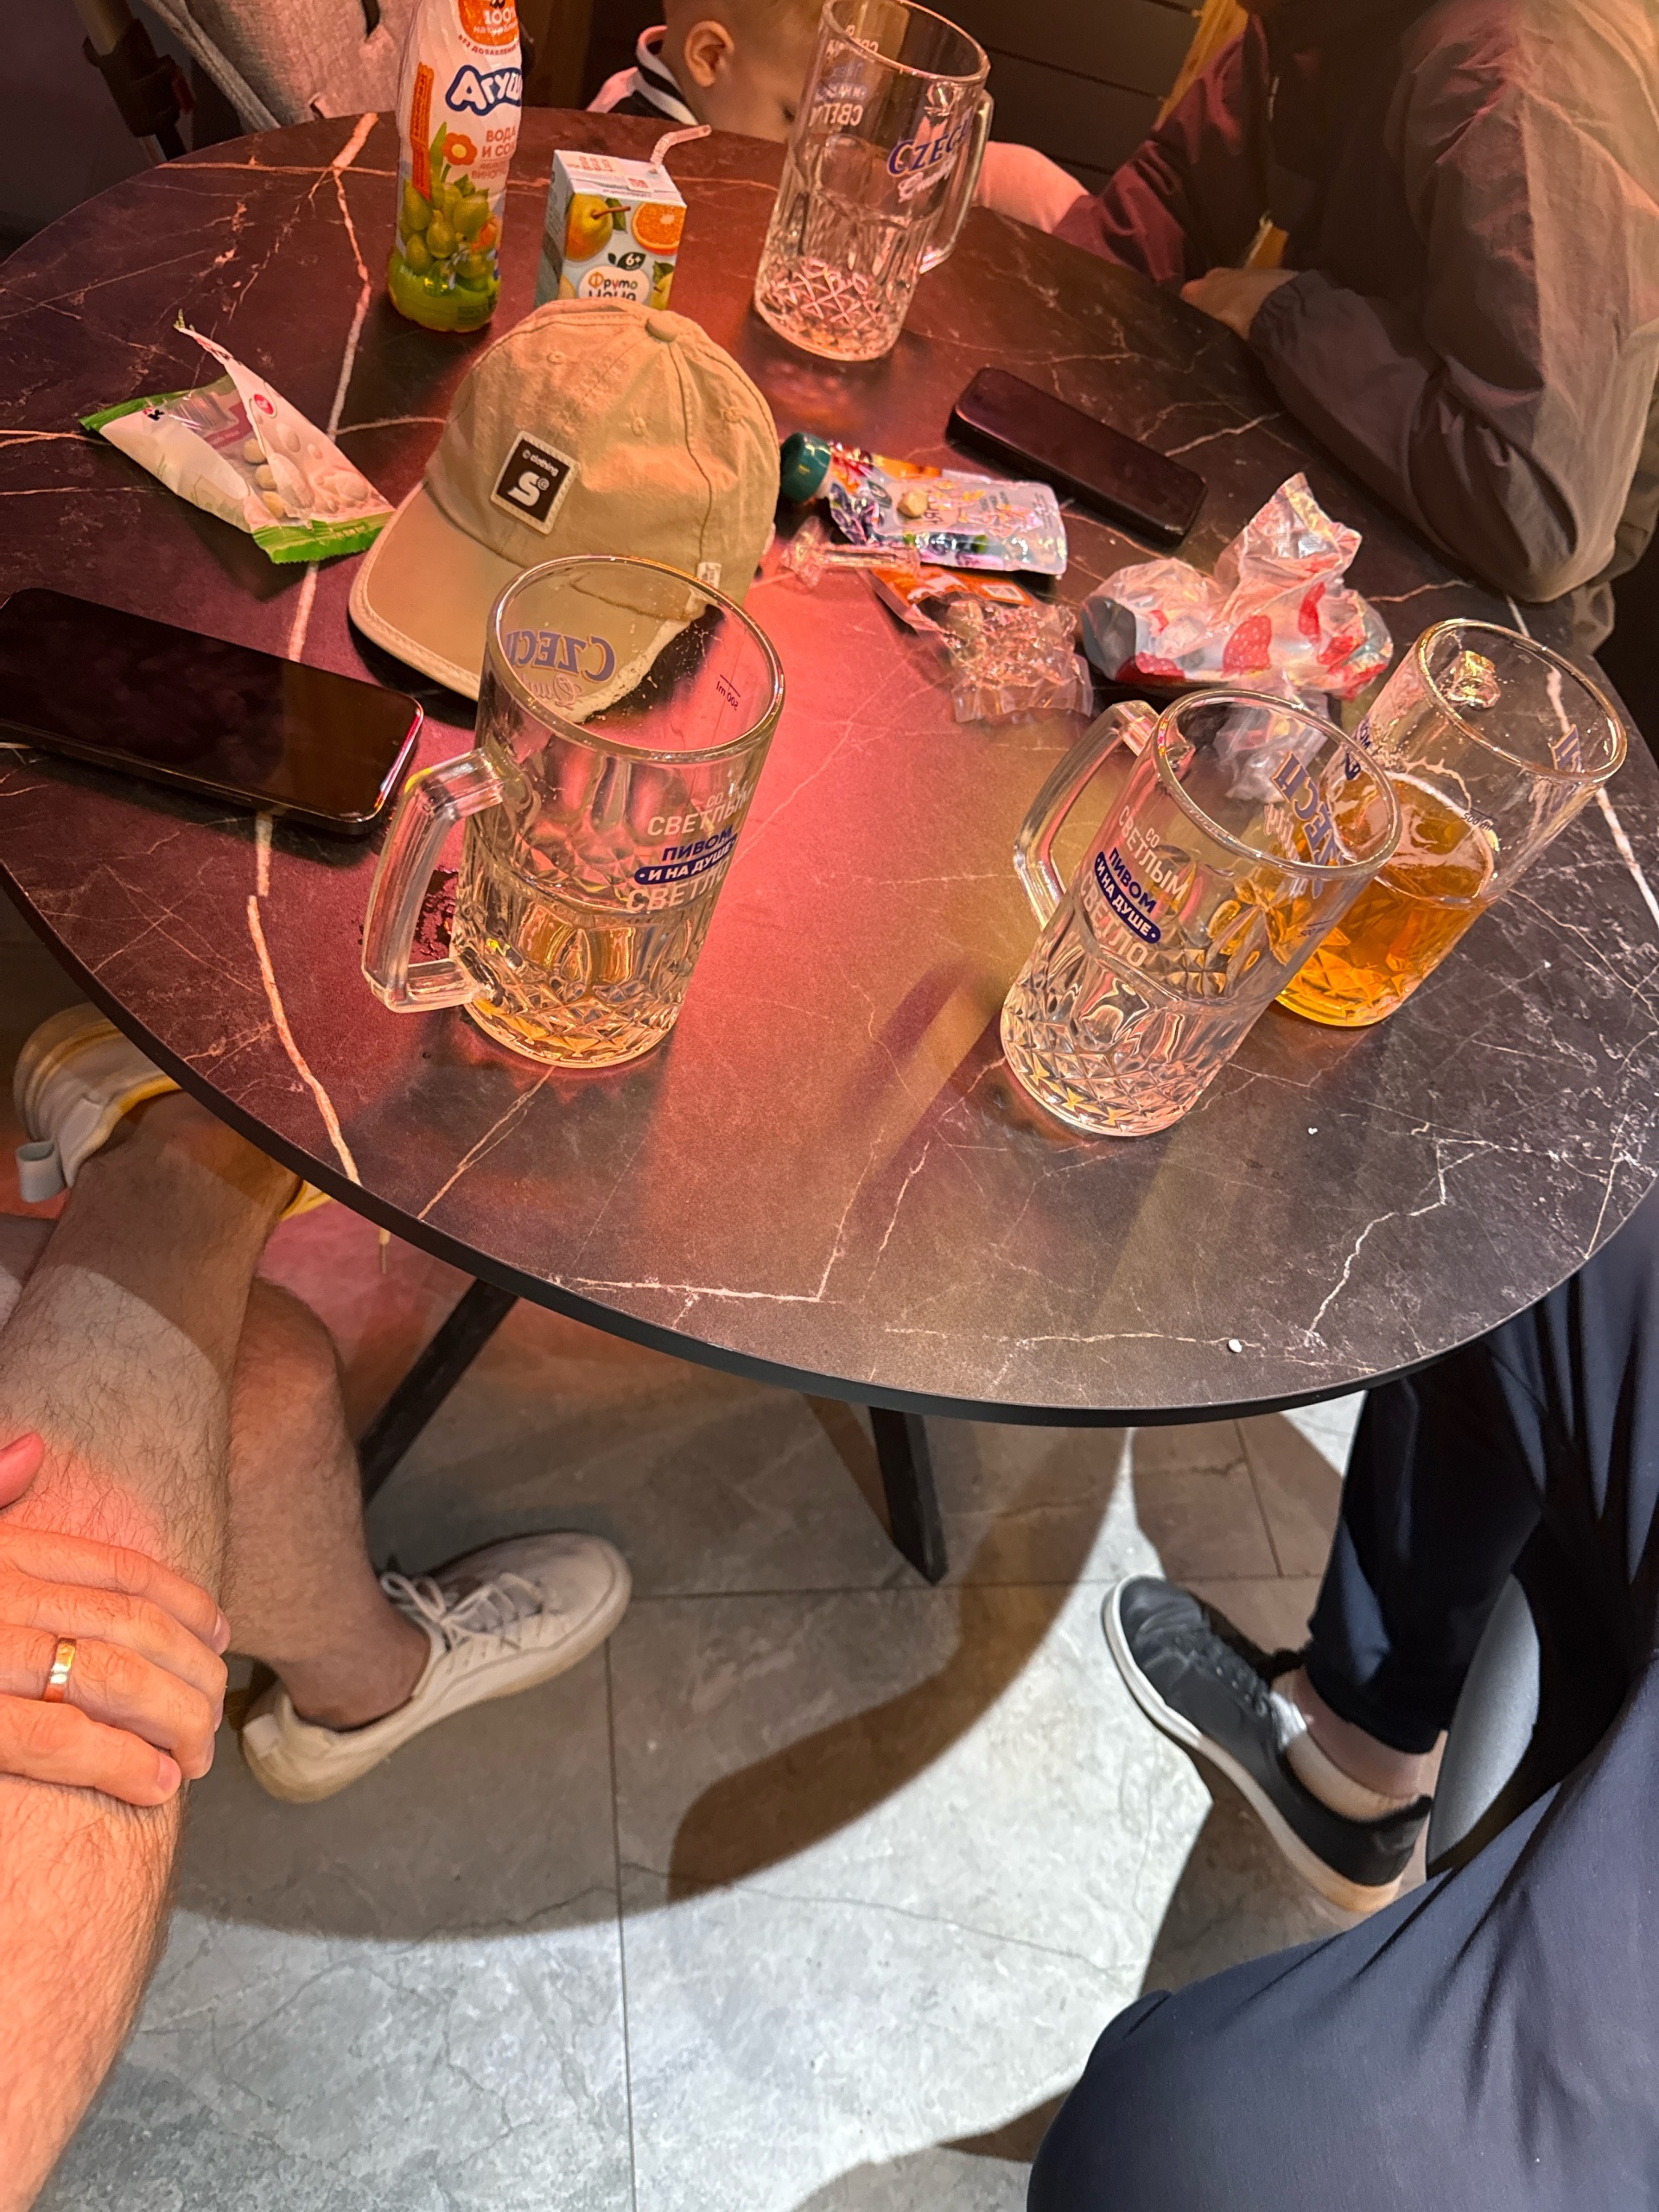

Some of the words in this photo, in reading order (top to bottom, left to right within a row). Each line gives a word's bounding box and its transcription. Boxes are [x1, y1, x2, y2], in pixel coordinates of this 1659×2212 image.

[662, 823, 733, 861] ПИВОМ
[1146, 827, 1160, 849] СО
[1460, 812, 1480, 826] 500
[648, 869, 662, 881] И
[665, 866, 689, 880] НА
[690, 843, 731, 875] ДУШЕ
[1108, 847, 1157, 914] ПИВОМ
[1118, 804, 1189, 901] СВЕТЛЫМ
[626, 855, 729, 912] СВЕТЛО
[1096, 861, 1104, 873] И
[1101, 874, 1115, 899] НА
[1111, 895, 1152, 937] ДУШЕ
[1080, 870, 1148, 967] СВЕТЛО
